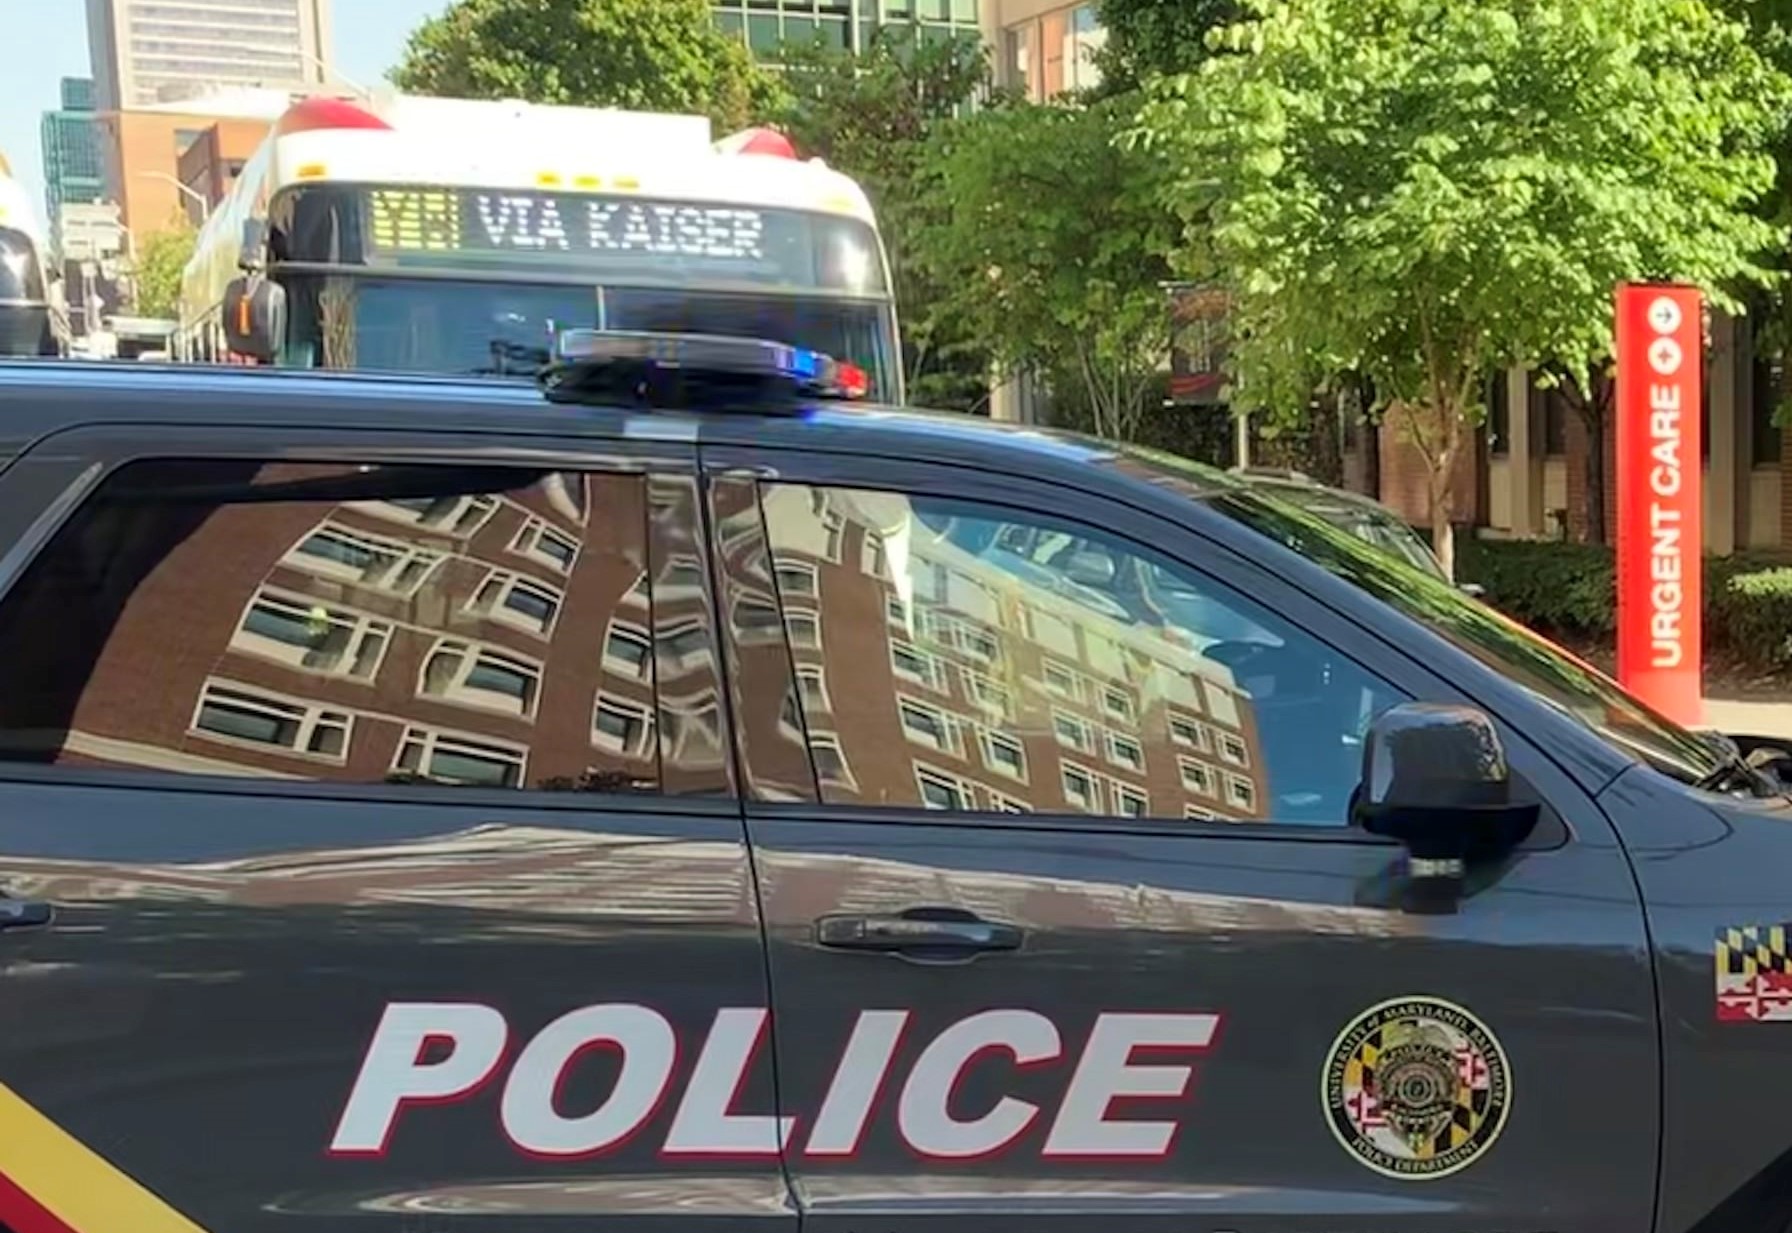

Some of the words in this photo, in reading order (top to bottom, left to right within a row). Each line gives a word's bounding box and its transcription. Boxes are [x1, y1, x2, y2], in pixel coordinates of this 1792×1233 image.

[478, 194, 570, 250] VIA
[588, 200, 763, 258] KAISER
[1650, 383, 1682, 497] CARE
[1650, 503, 1684, 669] URGENT
[326, 1000, 1221, 1161] POLICE
